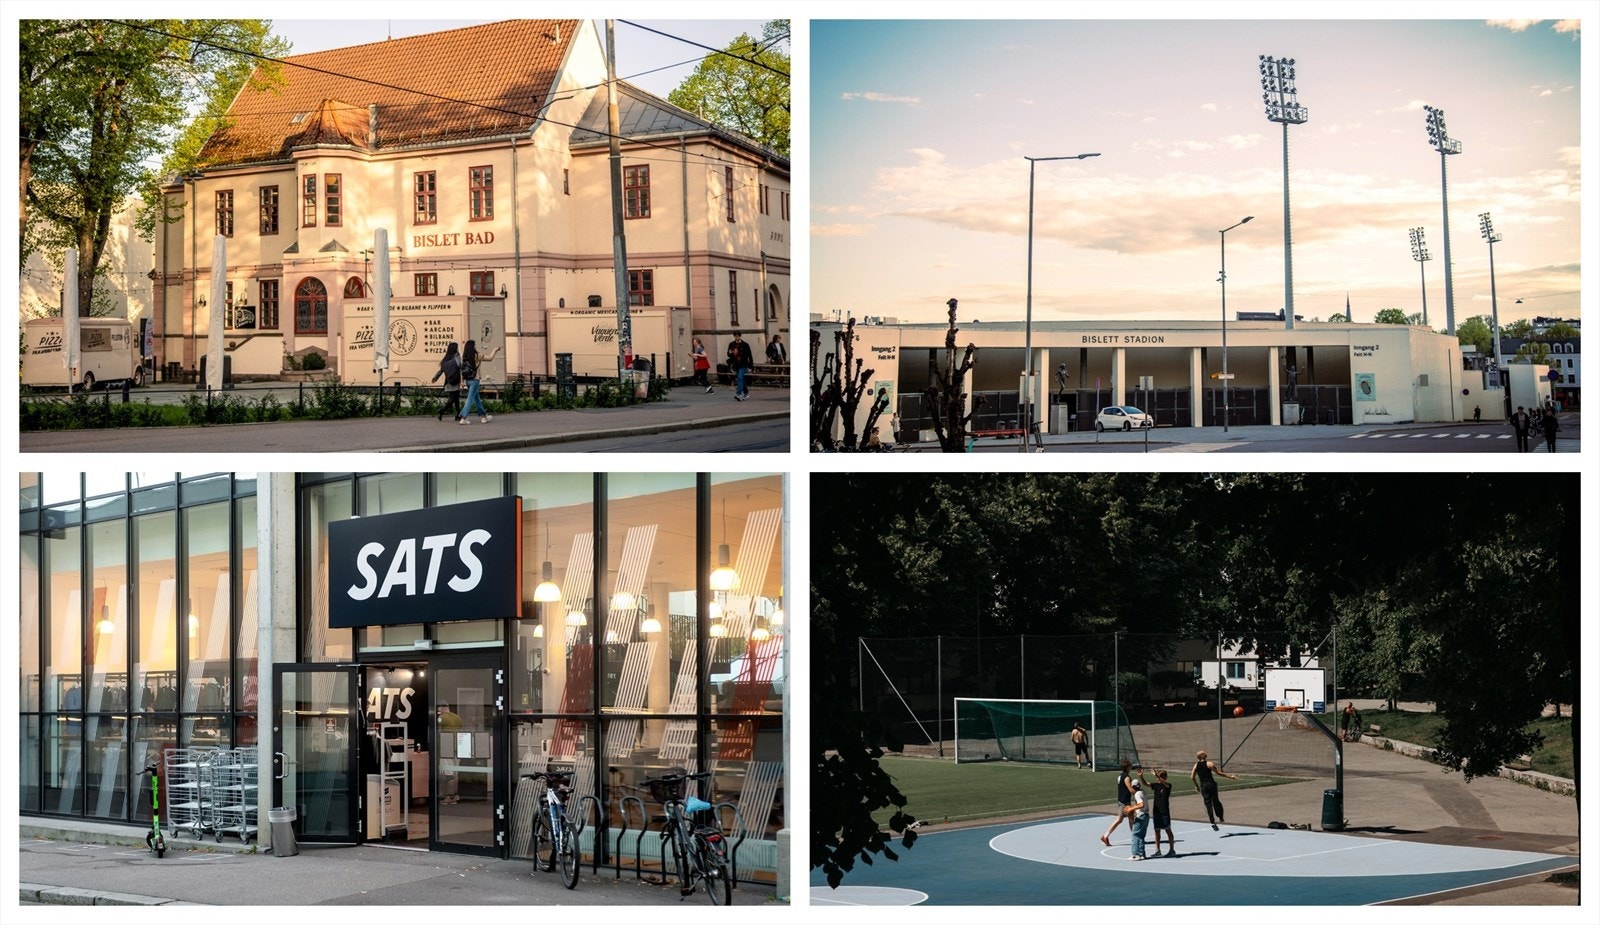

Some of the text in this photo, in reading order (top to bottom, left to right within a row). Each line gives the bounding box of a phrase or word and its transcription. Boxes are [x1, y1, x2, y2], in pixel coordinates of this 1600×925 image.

[413, 231, 495, 248] BISLET BAD
[355, 330, 374, 340] PIZZ
[1082, 335, 1164, 344] BISLETT STADION
[347, 529, 492, 600] SATS
[366, 687, 416, 720] ATS
